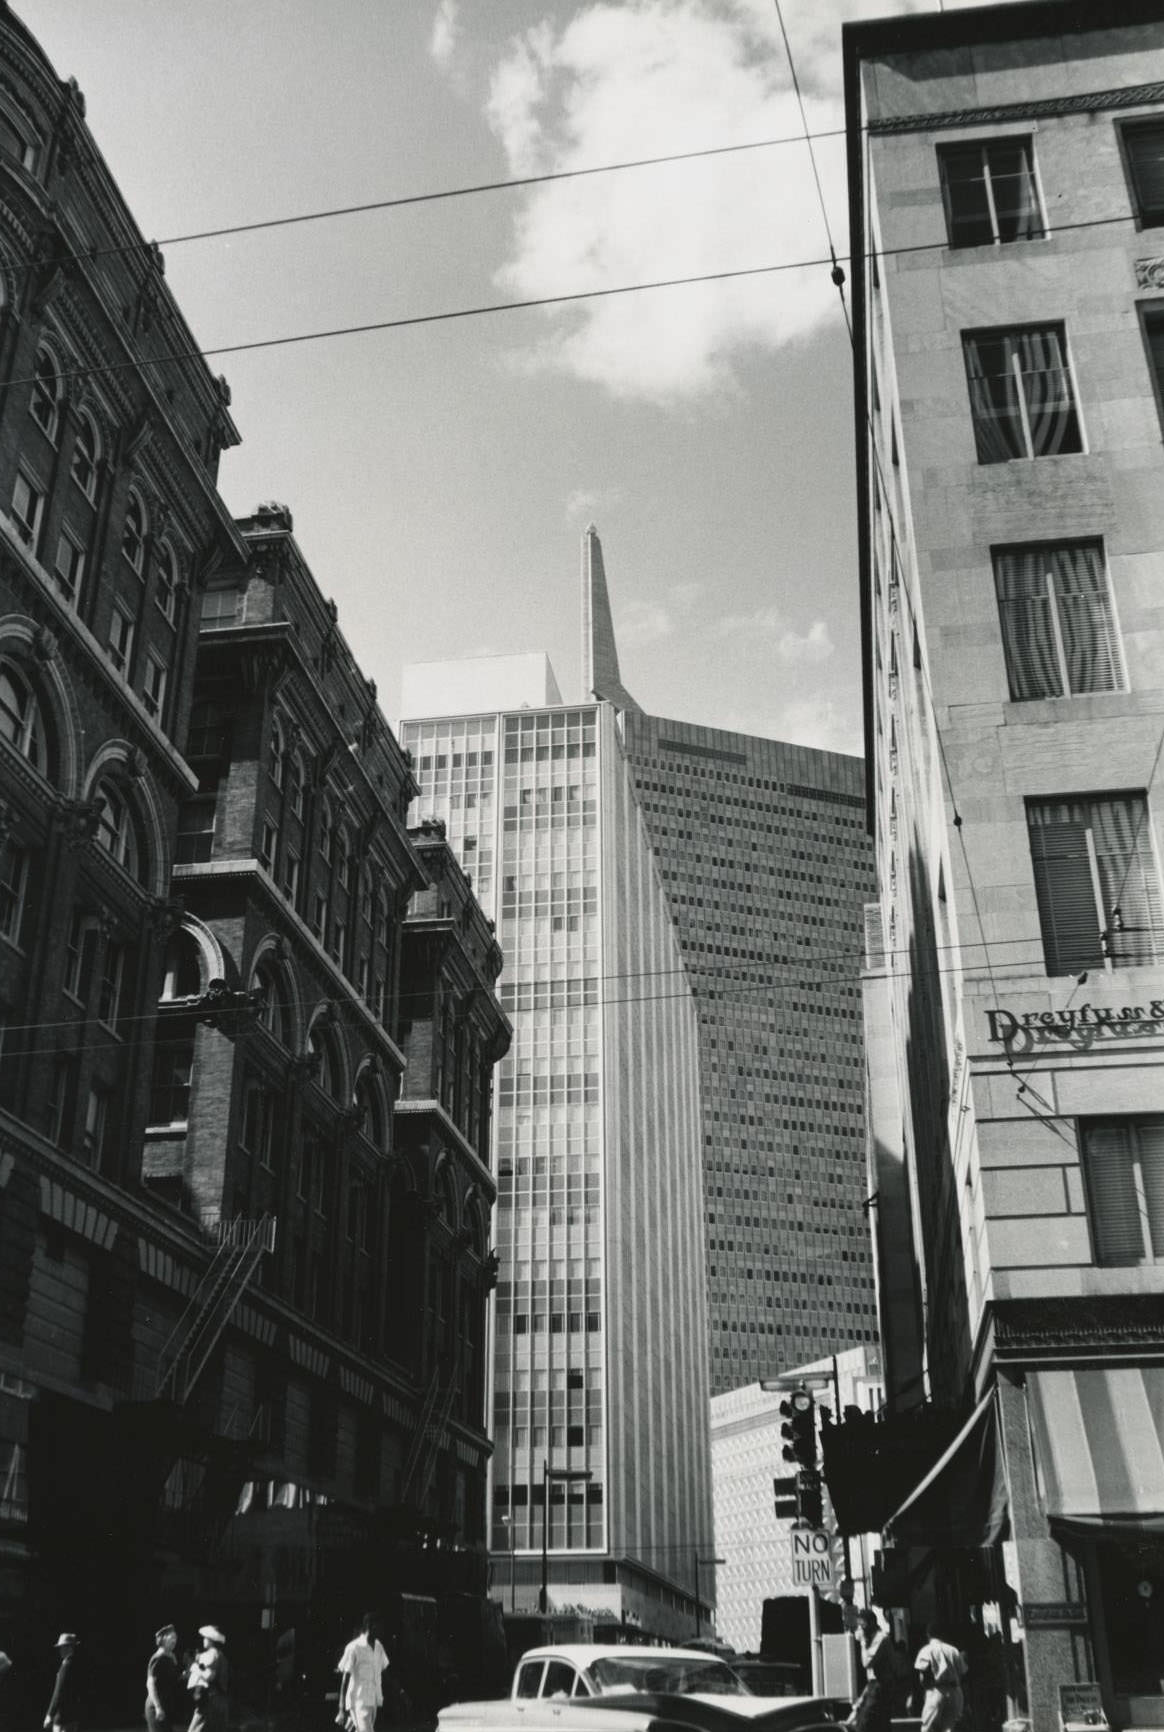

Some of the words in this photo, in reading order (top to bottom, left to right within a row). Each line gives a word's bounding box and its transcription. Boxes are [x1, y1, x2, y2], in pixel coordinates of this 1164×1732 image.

[984, 1003, 1145, 1042] Dreyfuss
[1150, 1000, 1164, 1019] &
[794, 1534, 829, 1554] NO
[795, 1560, 831, 1582] TURN
